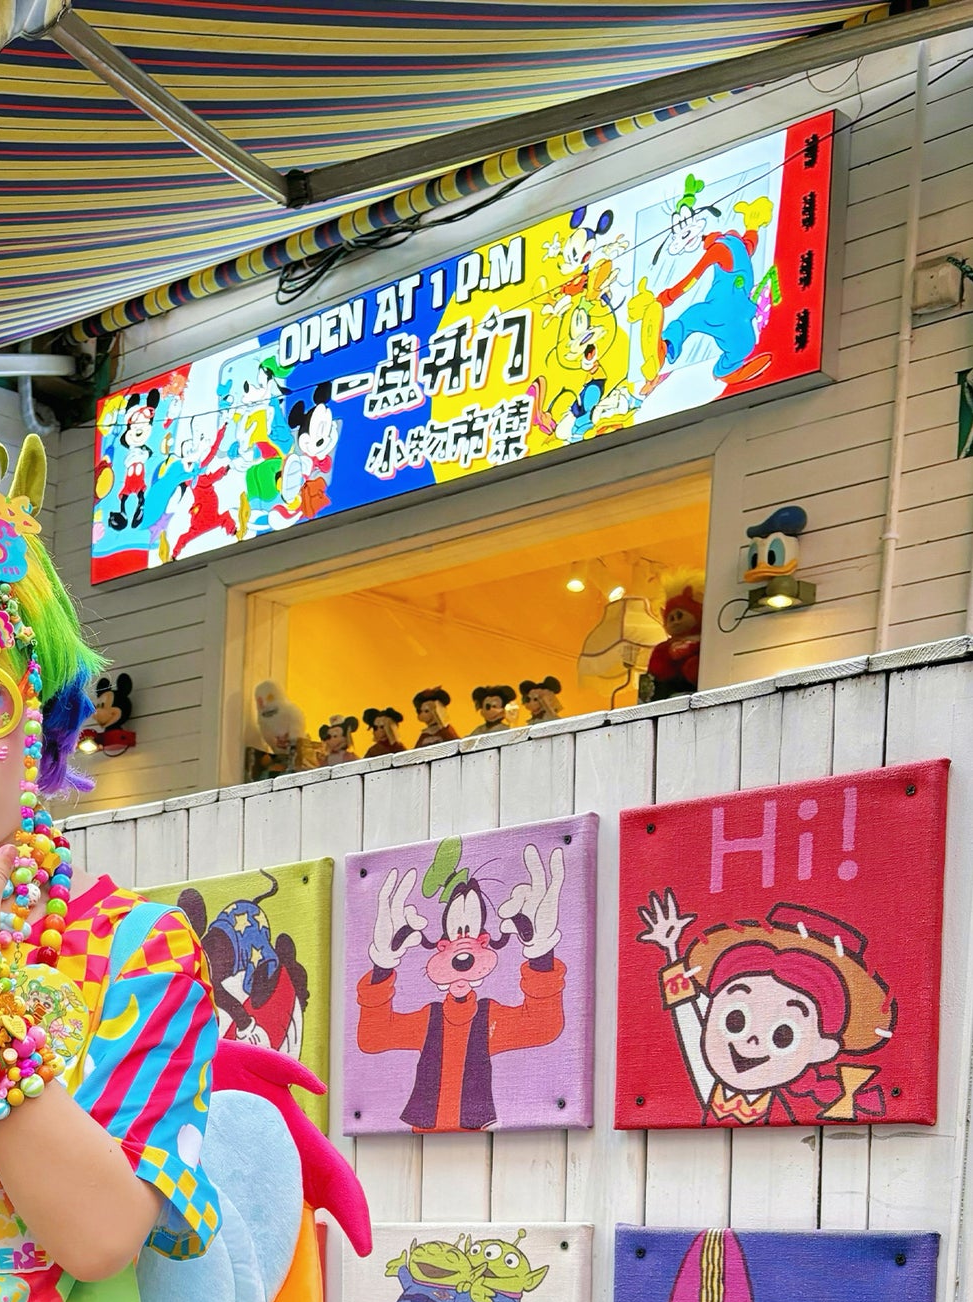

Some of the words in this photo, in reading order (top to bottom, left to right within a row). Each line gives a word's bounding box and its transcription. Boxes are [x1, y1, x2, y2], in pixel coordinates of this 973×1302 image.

[279, 298, 365, 367] OPEN
[373, 271, 421, 335] AT
[430, 268, 446, 310] 1
[456, 236, 526, 303] P.M
[332, 306, 534, 418] 一点开门
[365, 395, 534, 480] 小物市集
[709, 787, 859, 893] Hi!
